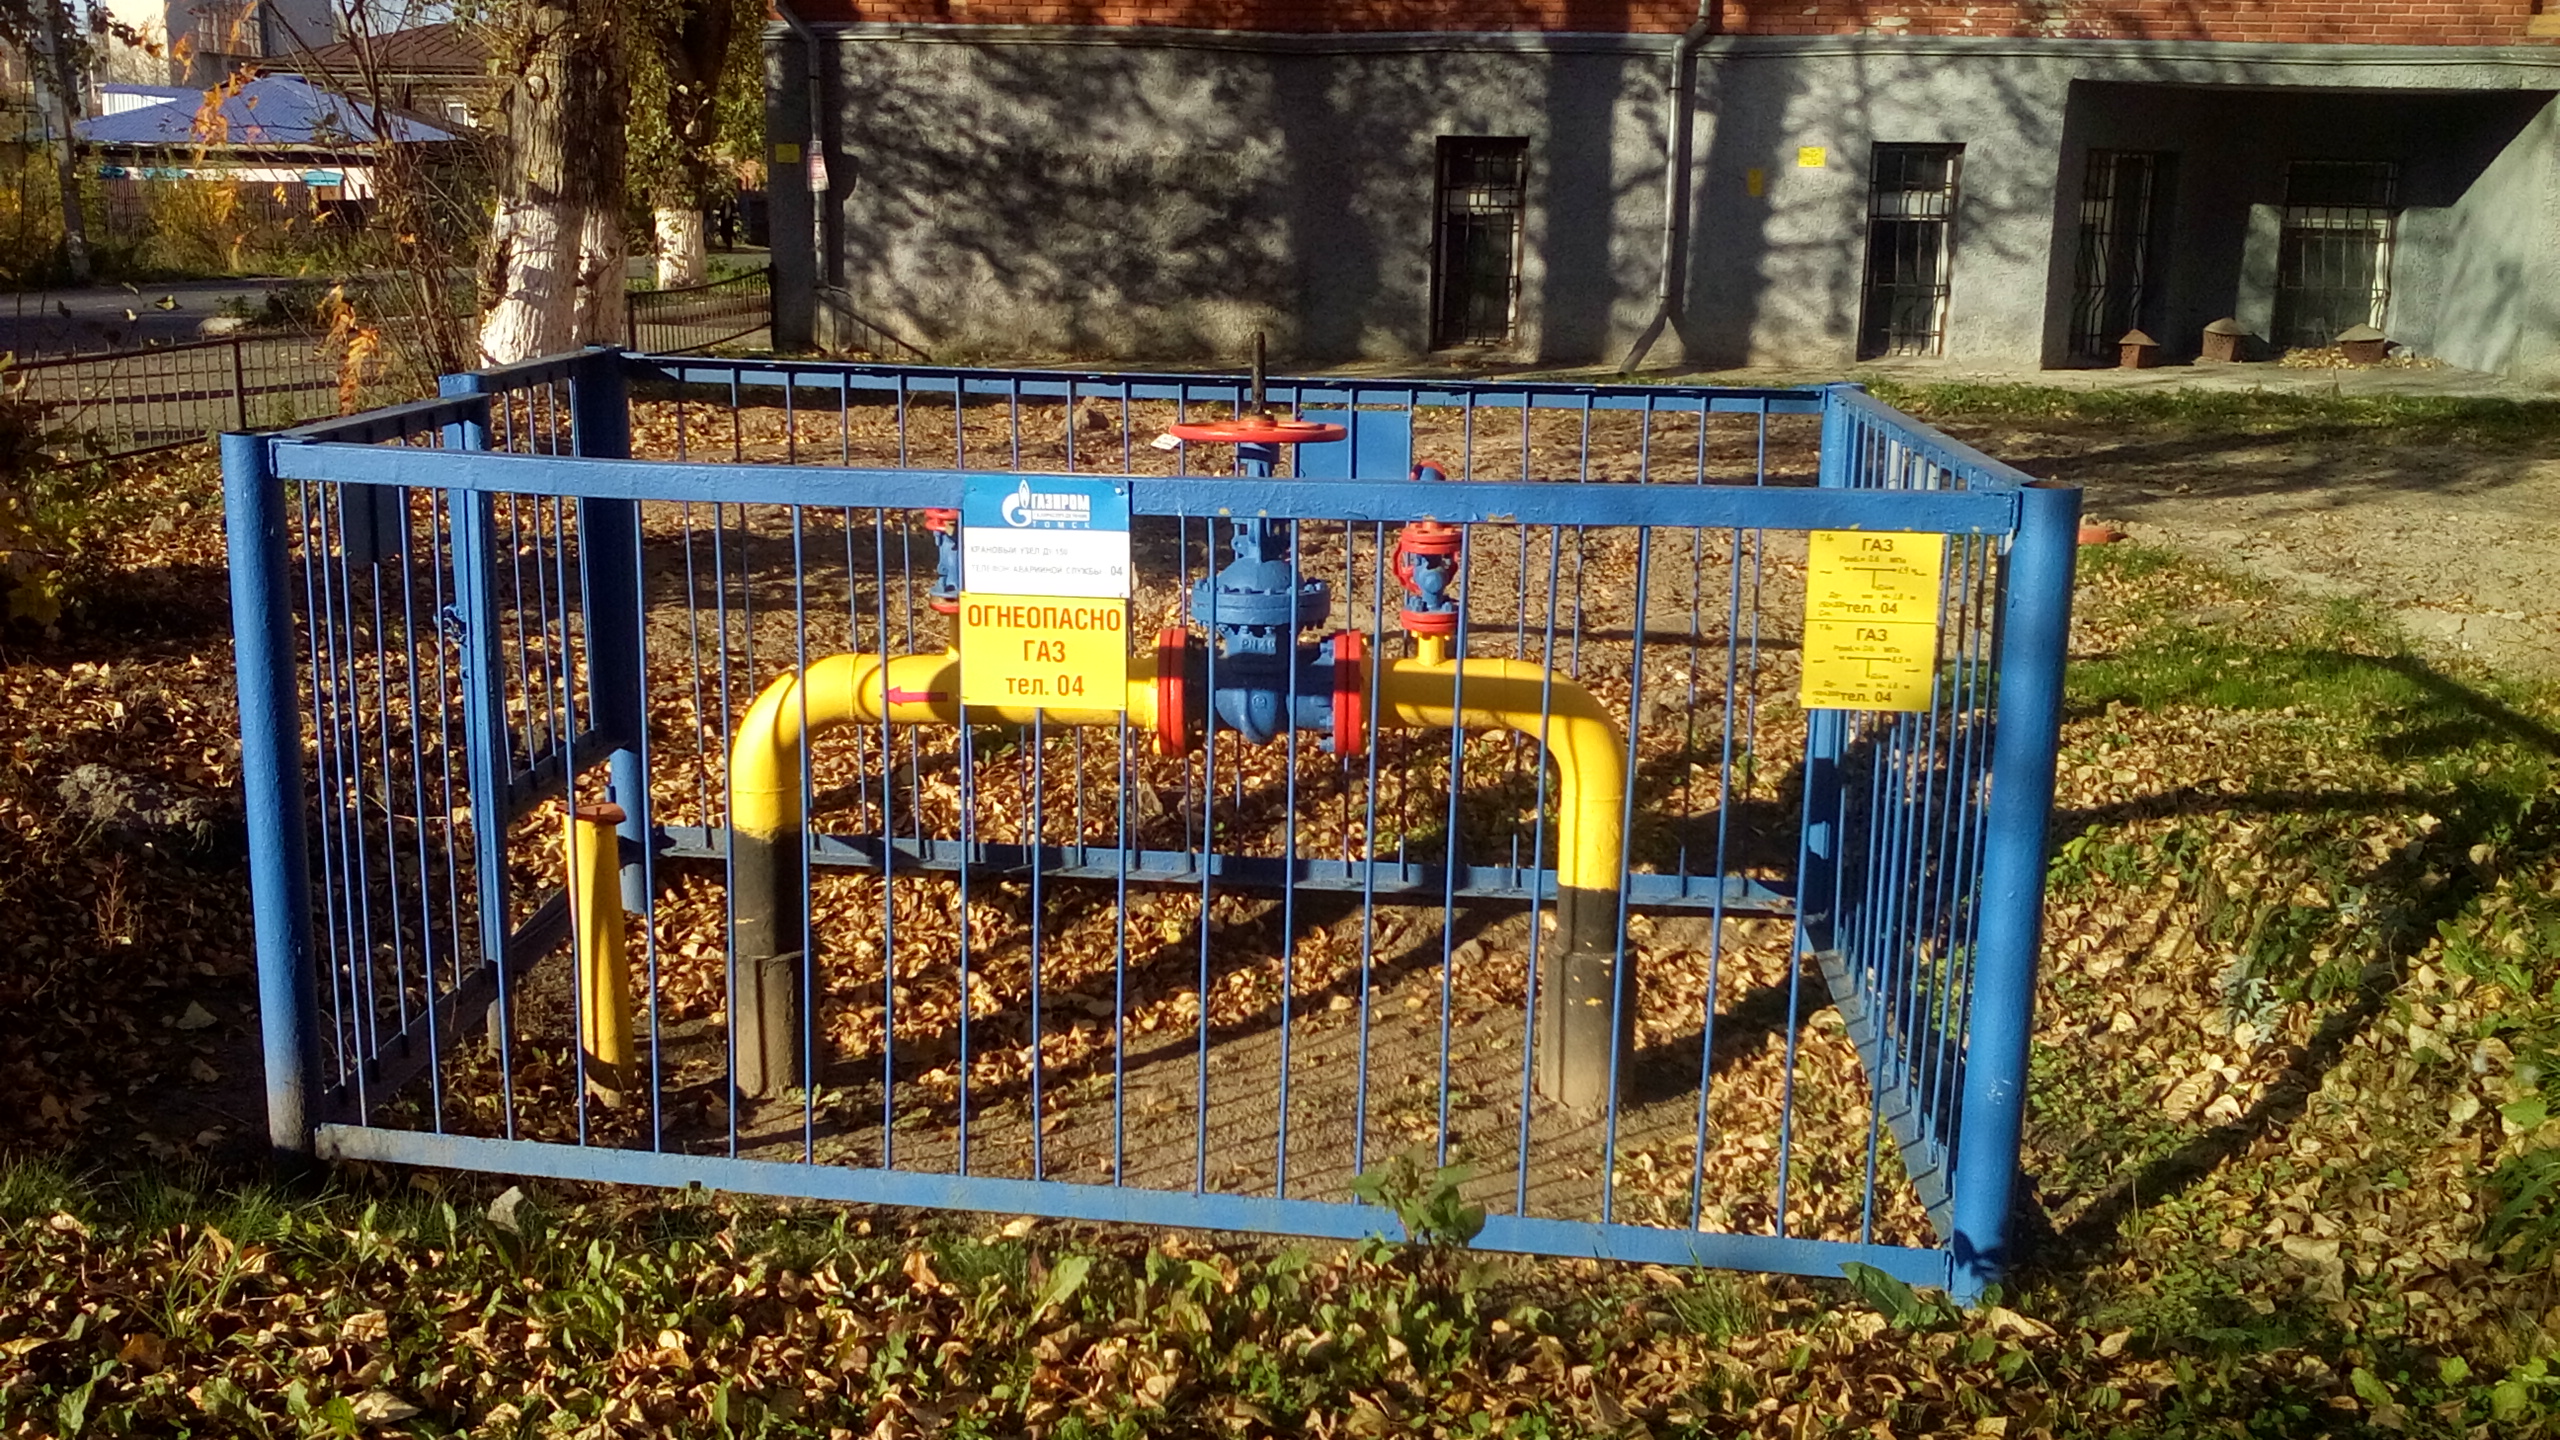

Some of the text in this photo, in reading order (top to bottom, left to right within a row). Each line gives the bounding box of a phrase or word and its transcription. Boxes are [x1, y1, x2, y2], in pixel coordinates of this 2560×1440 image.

[1031, 494, 1090, 510] ГАЗПРОМ
[1862, 538, 1894, 552] ГАЗ
[1110, 566, 1123, 576] 04
[1846, 603, 1875, 614] тел.
[1880, 602, 1898, 614] 04
[968, 604, 1120, 631] ОГНЕОПАСНО
[1856, 628, 1888, 642] ГАЗ
[1024, 640, 1066, 662] ГАЗ
[1006, 674, 1084, 696] тел. 04
[1841, 692, 1870, 702] тел.
[1874, 691, 1892, 702] 04
